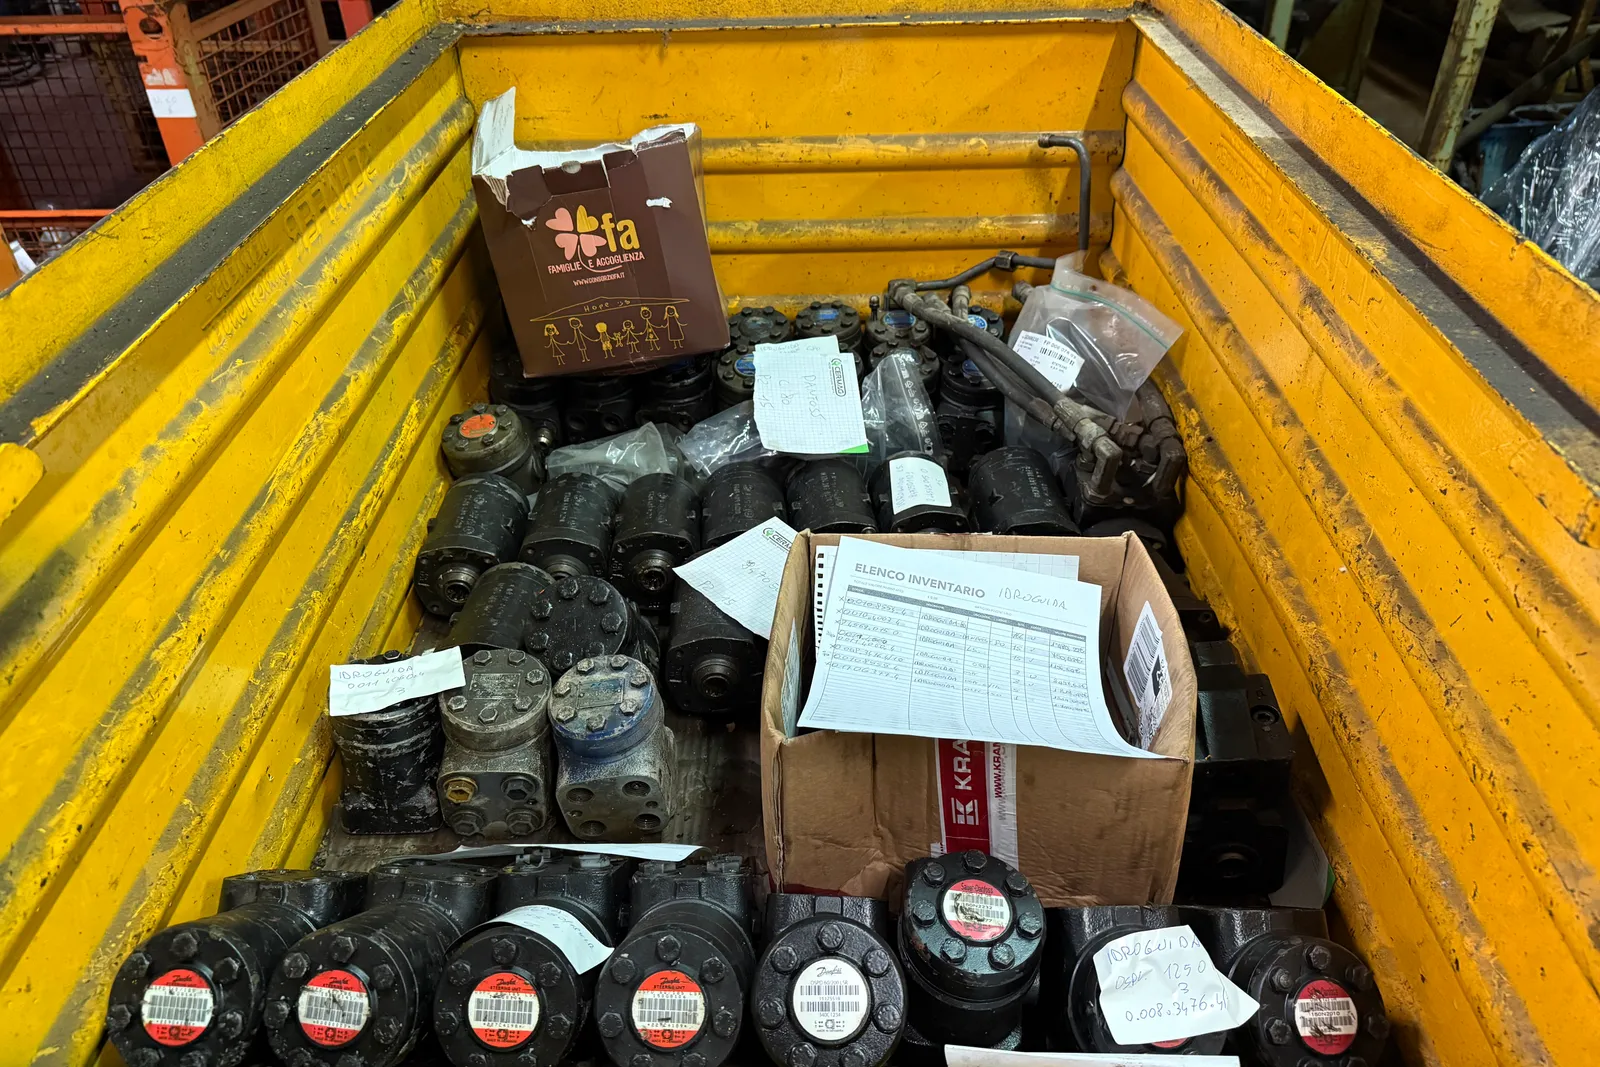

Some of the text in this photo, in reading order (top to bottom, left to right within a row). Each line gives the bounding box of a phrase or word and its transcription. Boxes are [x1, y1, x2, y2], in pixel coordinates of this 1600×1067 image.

[601, 212, 640, 252] fa
[548, 251, 645, 274] FAMIGLIE E ACCOGLIENZA
[572, 272, 625, 286] WWW.CONSORZIOFA.IT
[584, 302, 610, 312] Hope
[834, 366, 846, 396] CERMAG
[854, 562, 986, 598] ELENCO INVENTARIO
[999, 587, 1068, 610] IDROGUIDA
[340, 666, 412, 680] IDROGUIDA
[1108, 936, 1200, 964] IDROGUIDA
[816, 965, 842, 978] Danfoss
[1164, 960, 1206, 980] 1250
[1178, 982, 1190, 994] 3
